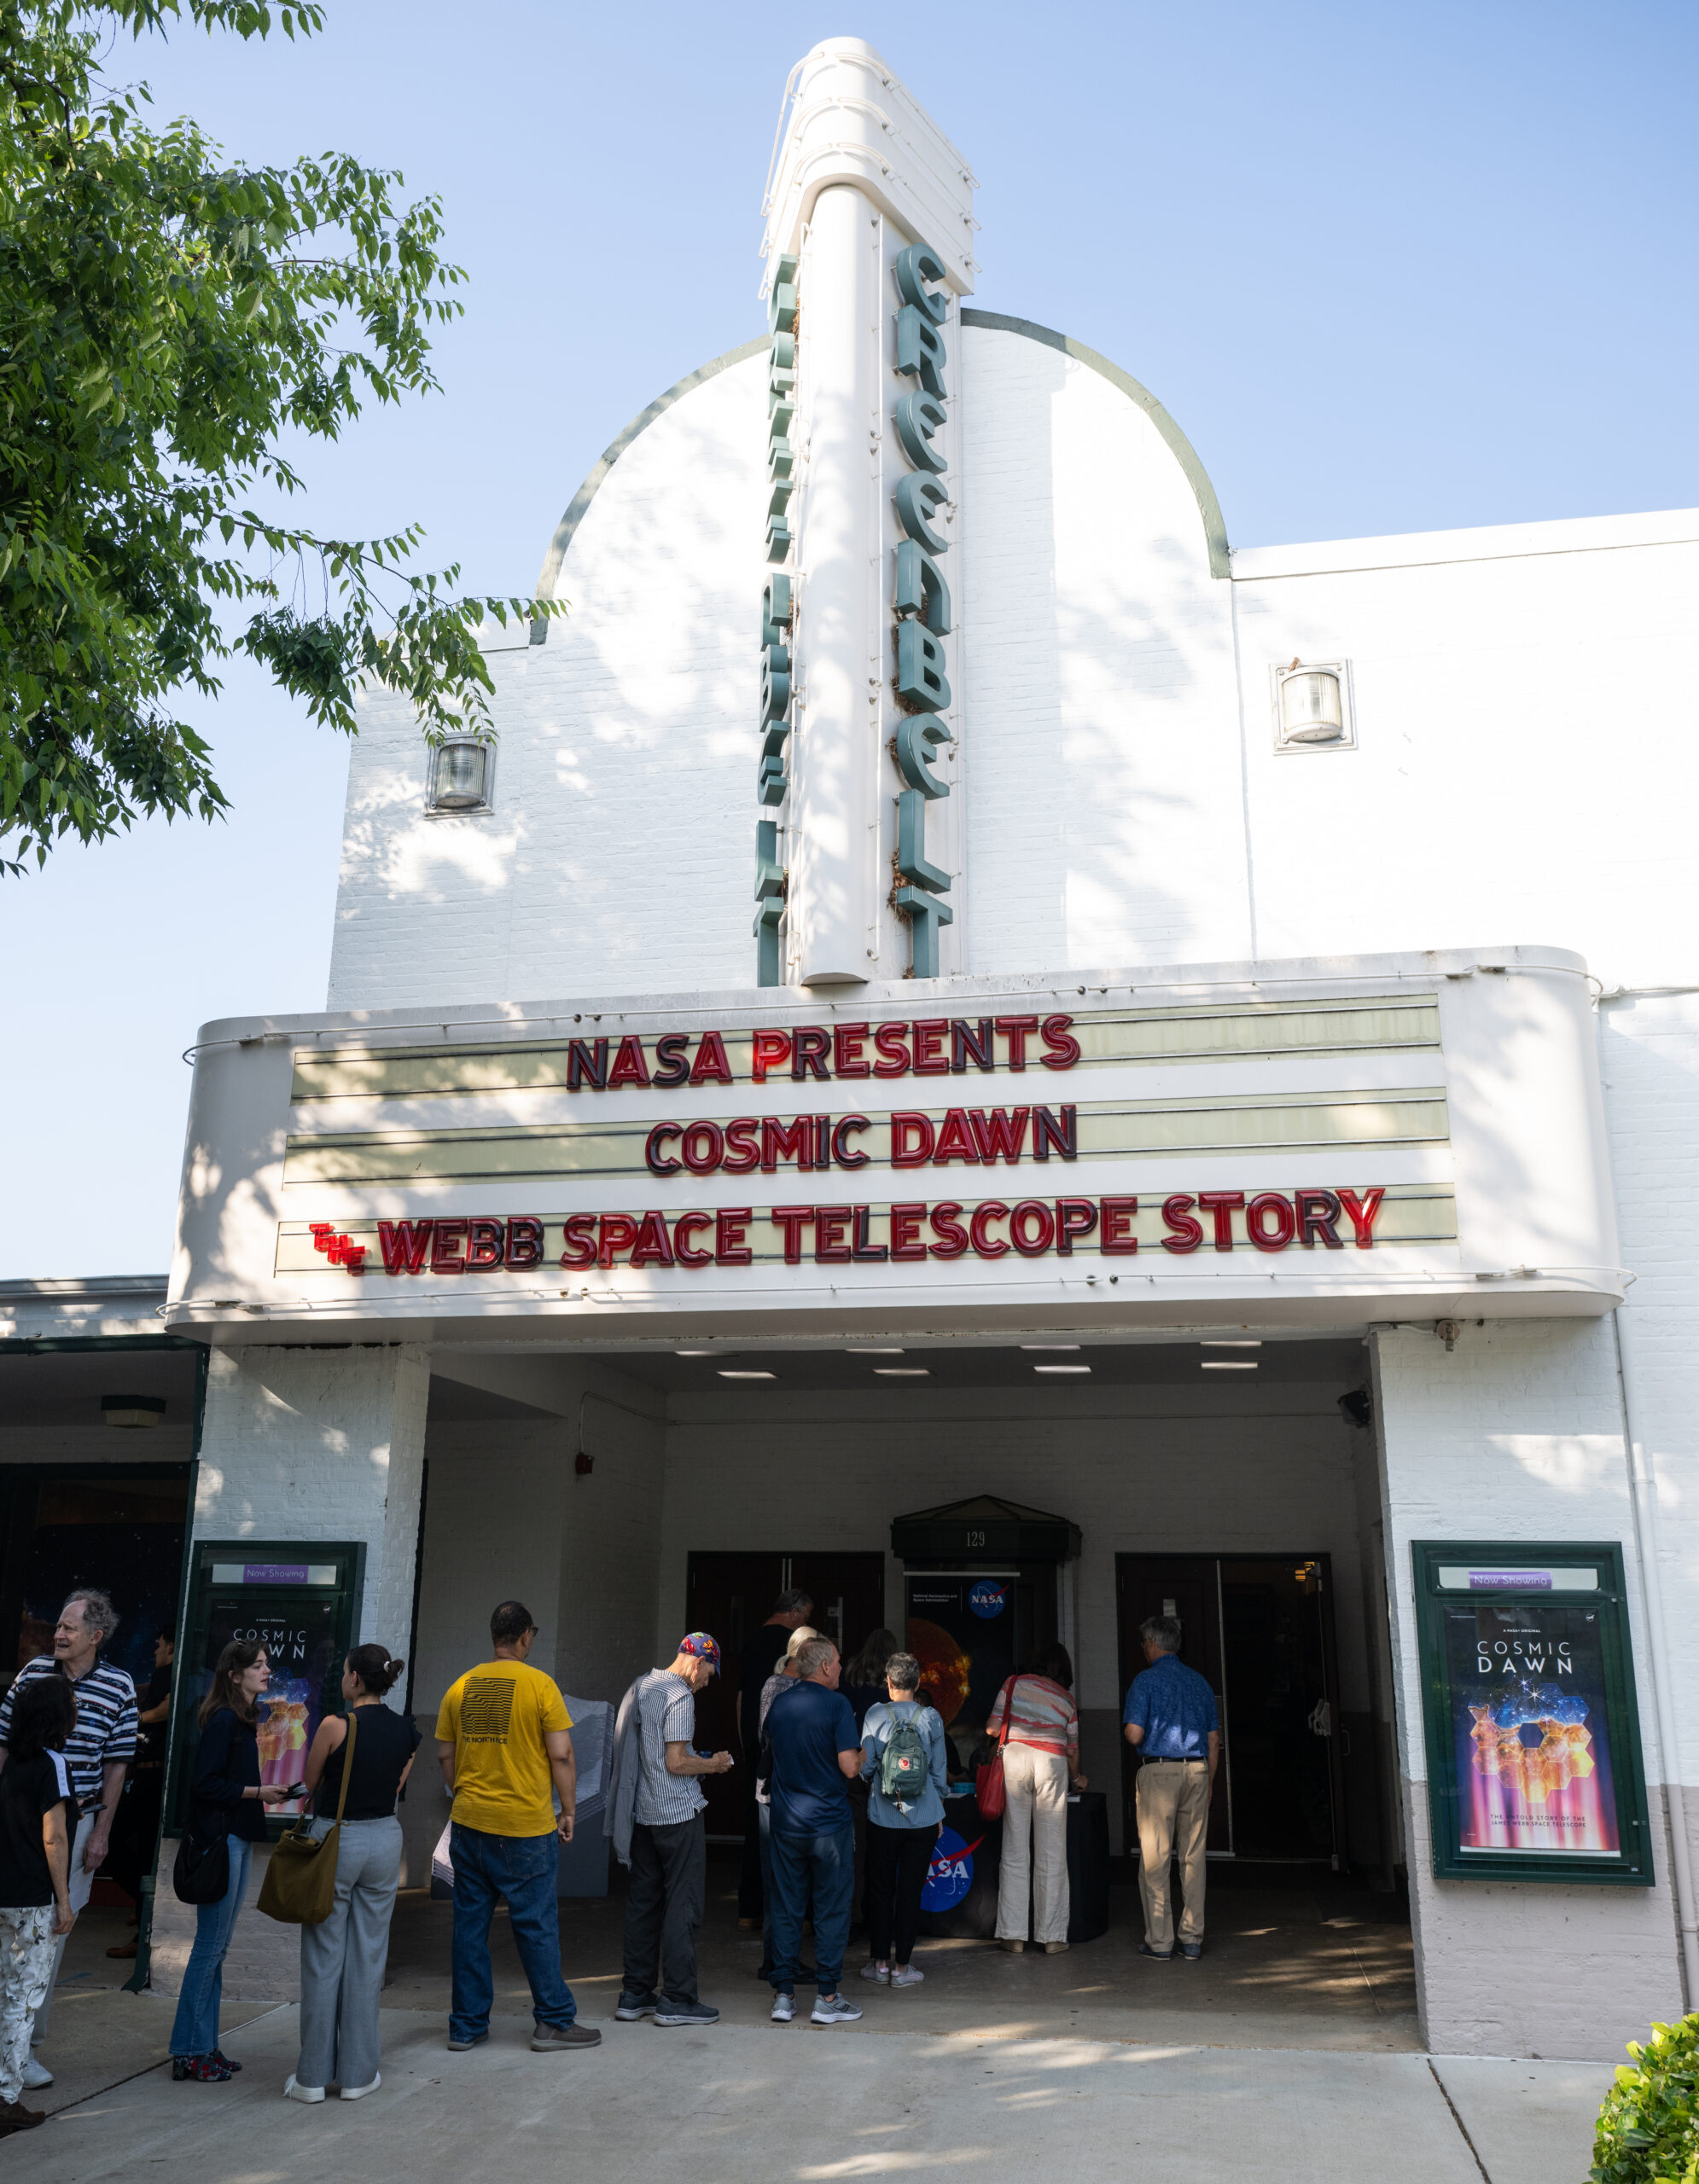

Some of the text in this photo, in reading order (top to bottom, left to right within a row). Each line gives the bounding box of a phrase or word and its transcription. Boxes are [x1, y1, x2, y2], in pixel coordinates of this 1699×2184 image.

[896, 242, 953, 979] GREENBELT
[567, 1014, 1081, 1090] NASA PRESENTS
[645, 1104, 1077, 1176] COSMIC DAWN
[309, 1187, 1386, 1275] THE WEBB SPACE TELESCOPE STORY
[967, 1531, 985, 1547] 129
[269, 1569, 305, 1579] Showing
[1475, 1575, 1547, 1587] Now Showing
[971, 1594, 1004, 1604] NASA
[233, 1629, 306, 1642] COSMIC
[268, 1643, 305, 1659] WN
[1477, 1641, 1570, 1656] COSMIC
[1477, 1657, 1573, 1675] DAWN
[927, 1859, 969, 1879] ASA
